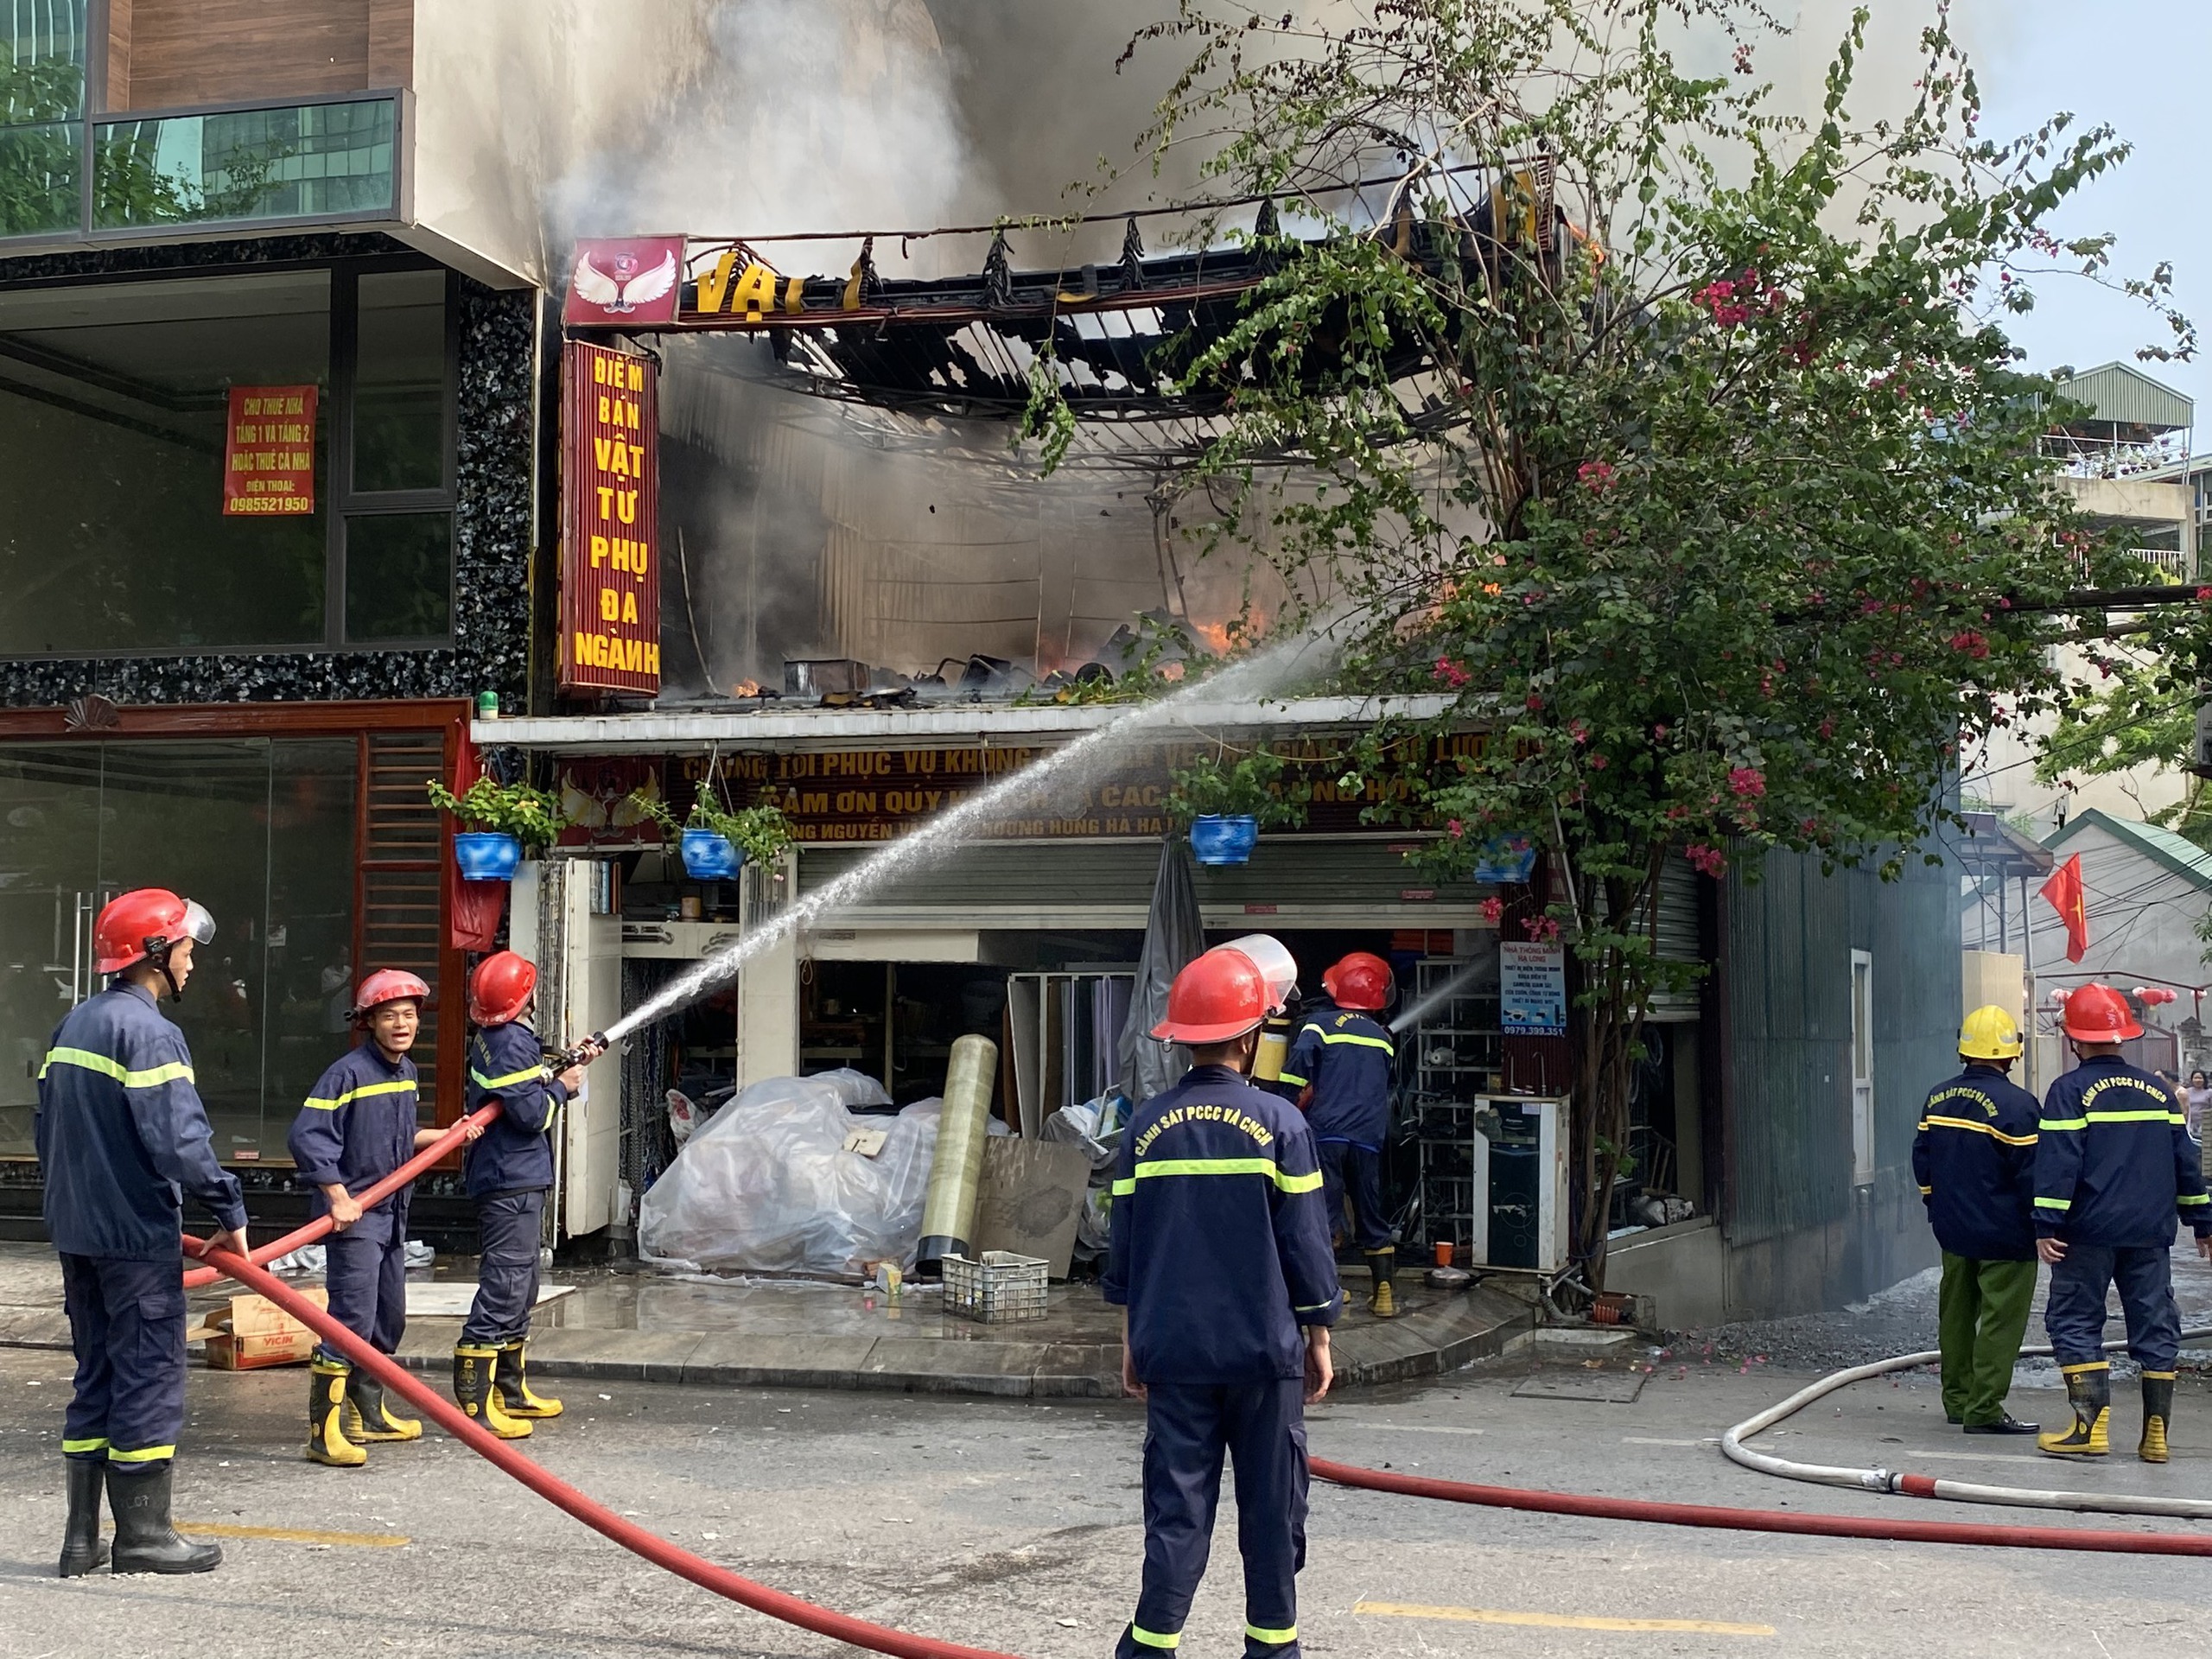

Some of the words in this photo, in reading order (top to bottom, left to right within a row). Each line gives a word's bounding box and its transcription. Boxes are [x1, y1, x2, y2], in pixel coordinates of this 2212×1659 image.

[594, 355, 644, 393] ĐIỂM
[244, 397, 261, 416] CHO
[263, 394, 284, 416] THUÊ
[258, 425, 263, 442] 1
[265, 421, 276, 442] VÀ
[303, 424, 309, 442] 2
[256, 448, 276, 471] THUÊ
[278, 446, 290, 471] CẢ
[292, 448, 310, 471] NHÀ
[594, 433, 645, 482] VẬT
[230, 497, 308, 512] 0985521950
[596, 486, 639, 524] TƯ
[590, 535, 648, 583] PHỤ
[601, 588, 639, 625] ĐA
[575, 627, 659, 675] NGÀNH
[823, 751, 892, 780] PHỤC
[904, 750, 938, 780] VỤ
[836, 790, 877, 813] ƠN
[1160, 1109, 1184, 1130] SÁT
[1186, 1104, 1223, 1122] PCCC
[1222, 1108, 1242, 1127] VÀ
[1238, 1116, 1274, 1147] CNCH
